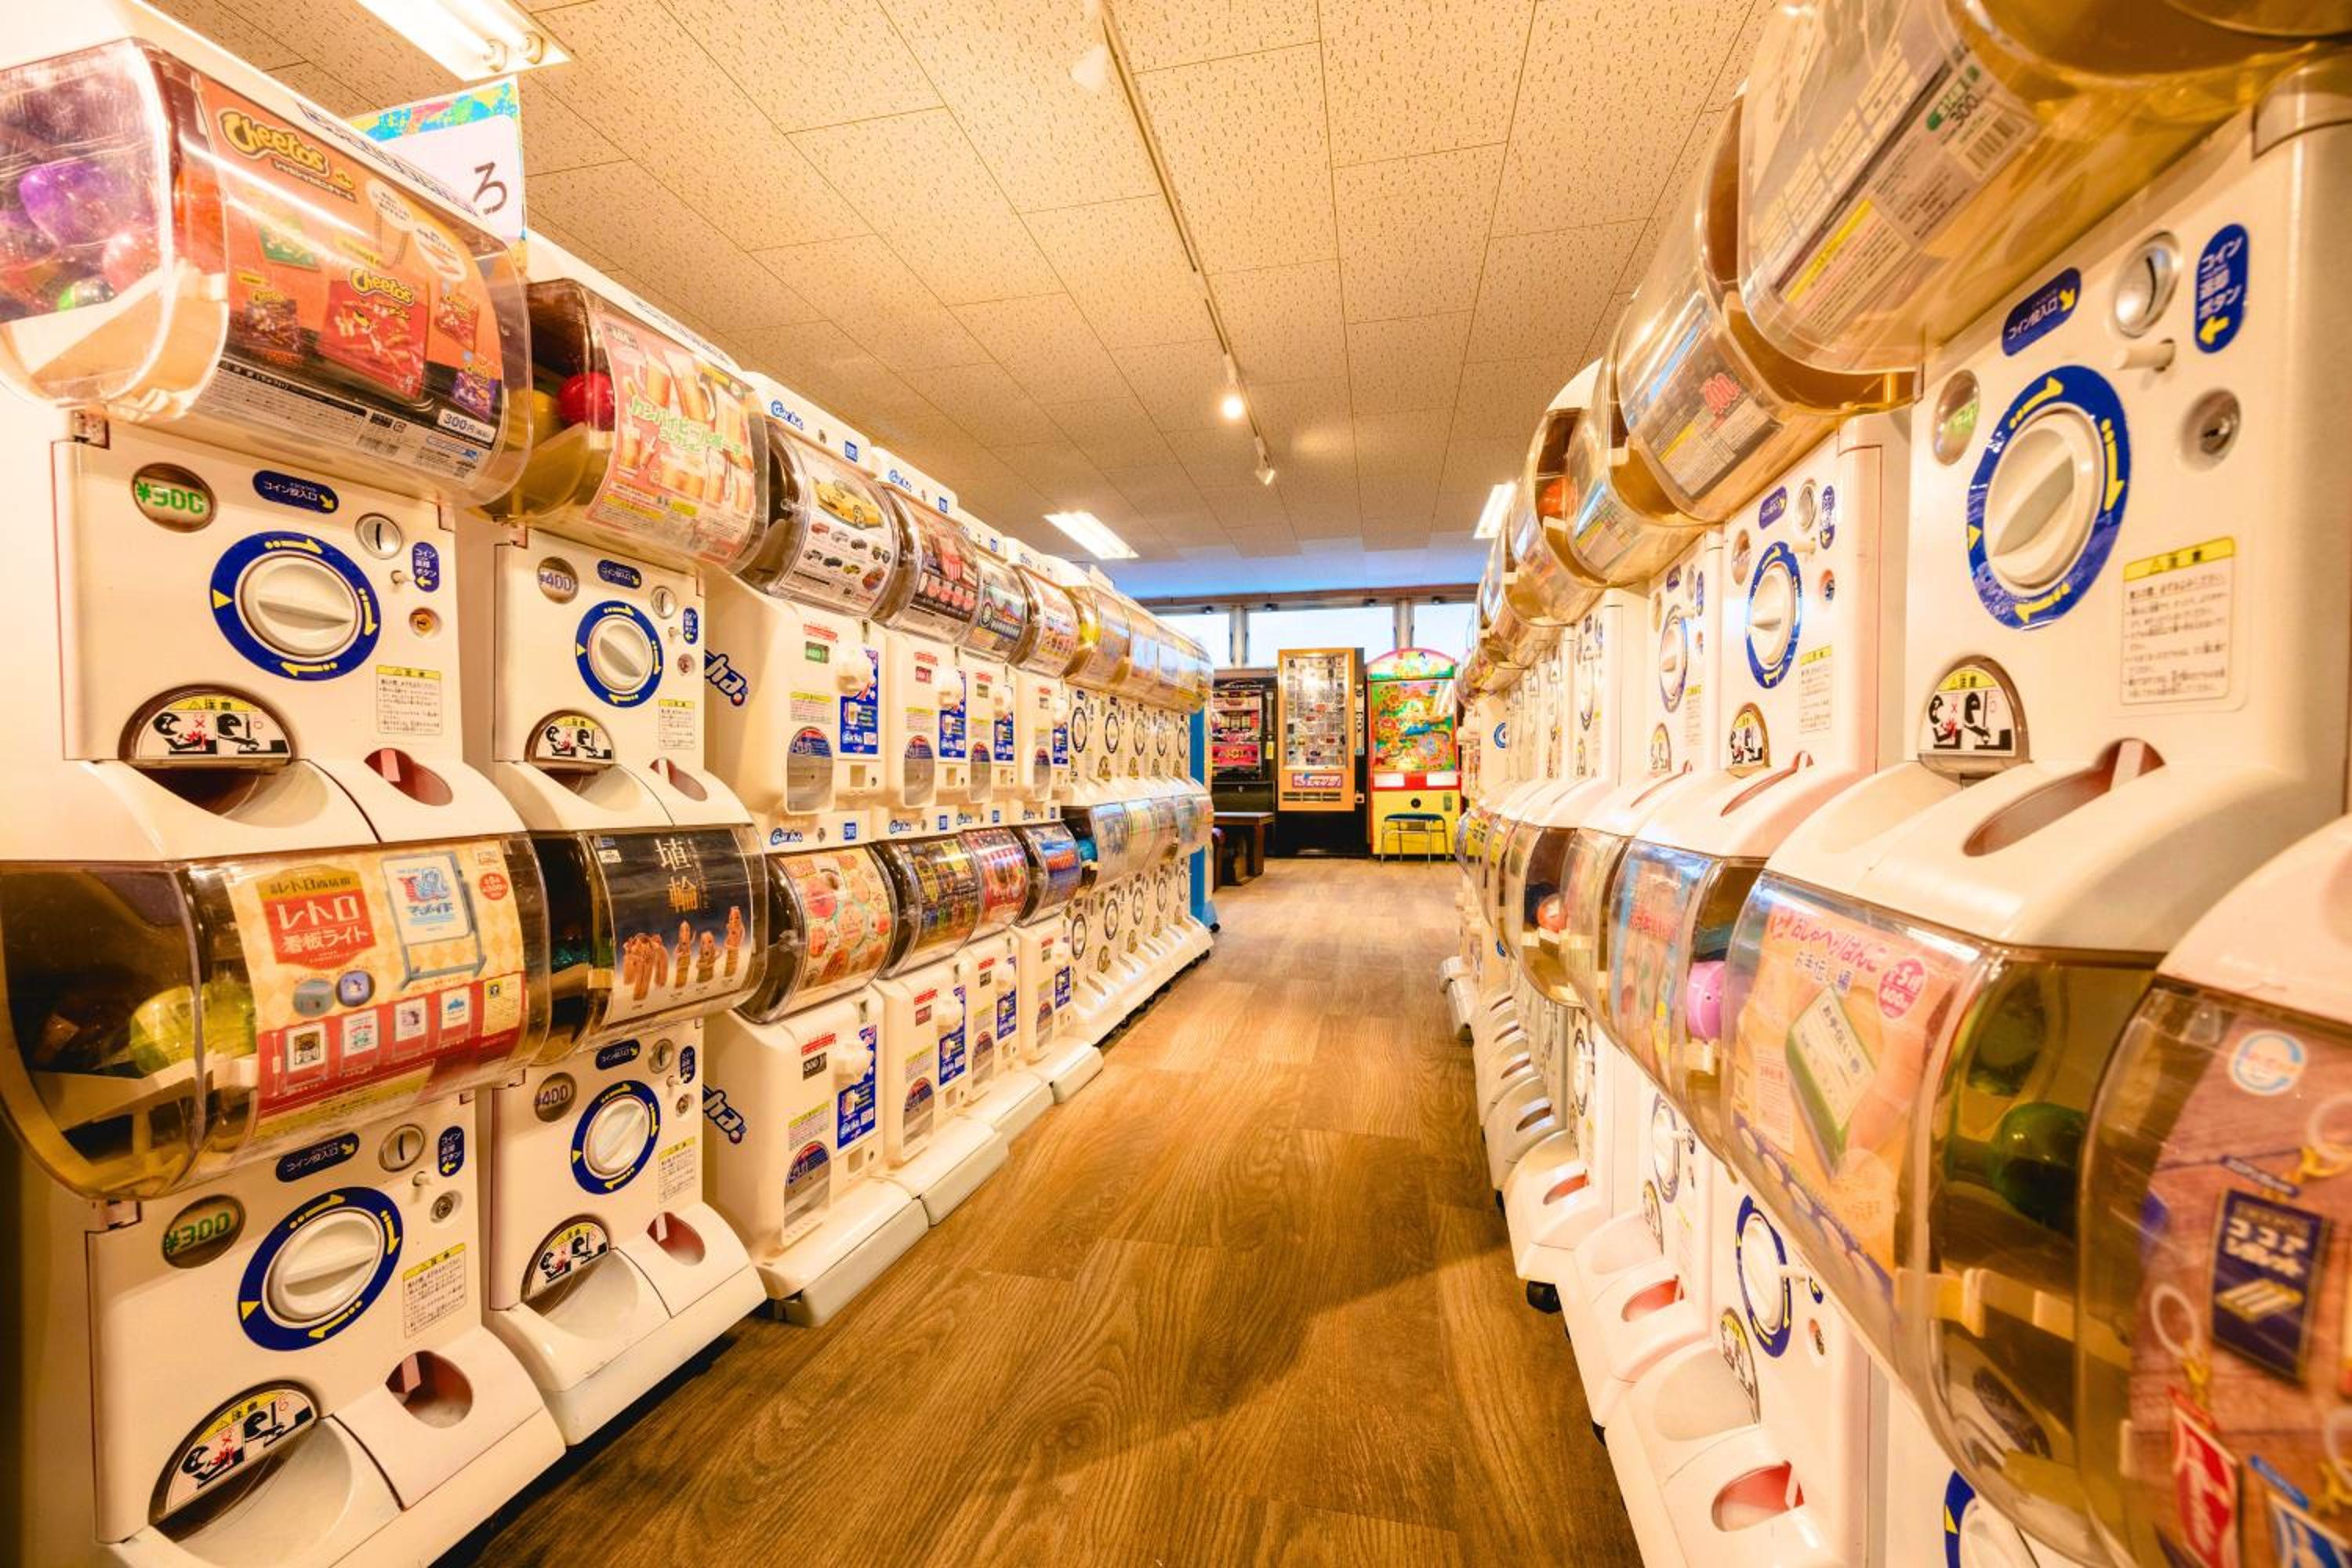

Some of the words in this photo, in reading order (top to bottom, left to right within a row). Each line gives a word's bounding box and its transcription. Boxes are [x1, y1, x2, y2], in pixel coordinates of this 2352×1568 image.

[220, 110, 331, 177] Cheetos
[2200, 238, 2243, 271] コイン
[350, 269, 416, 307] Cheetos
[416, 548, 436, 560] コイン
[276, 895, 361, 931] レトロ
[282, 925, 369, 954] 看板ライト
